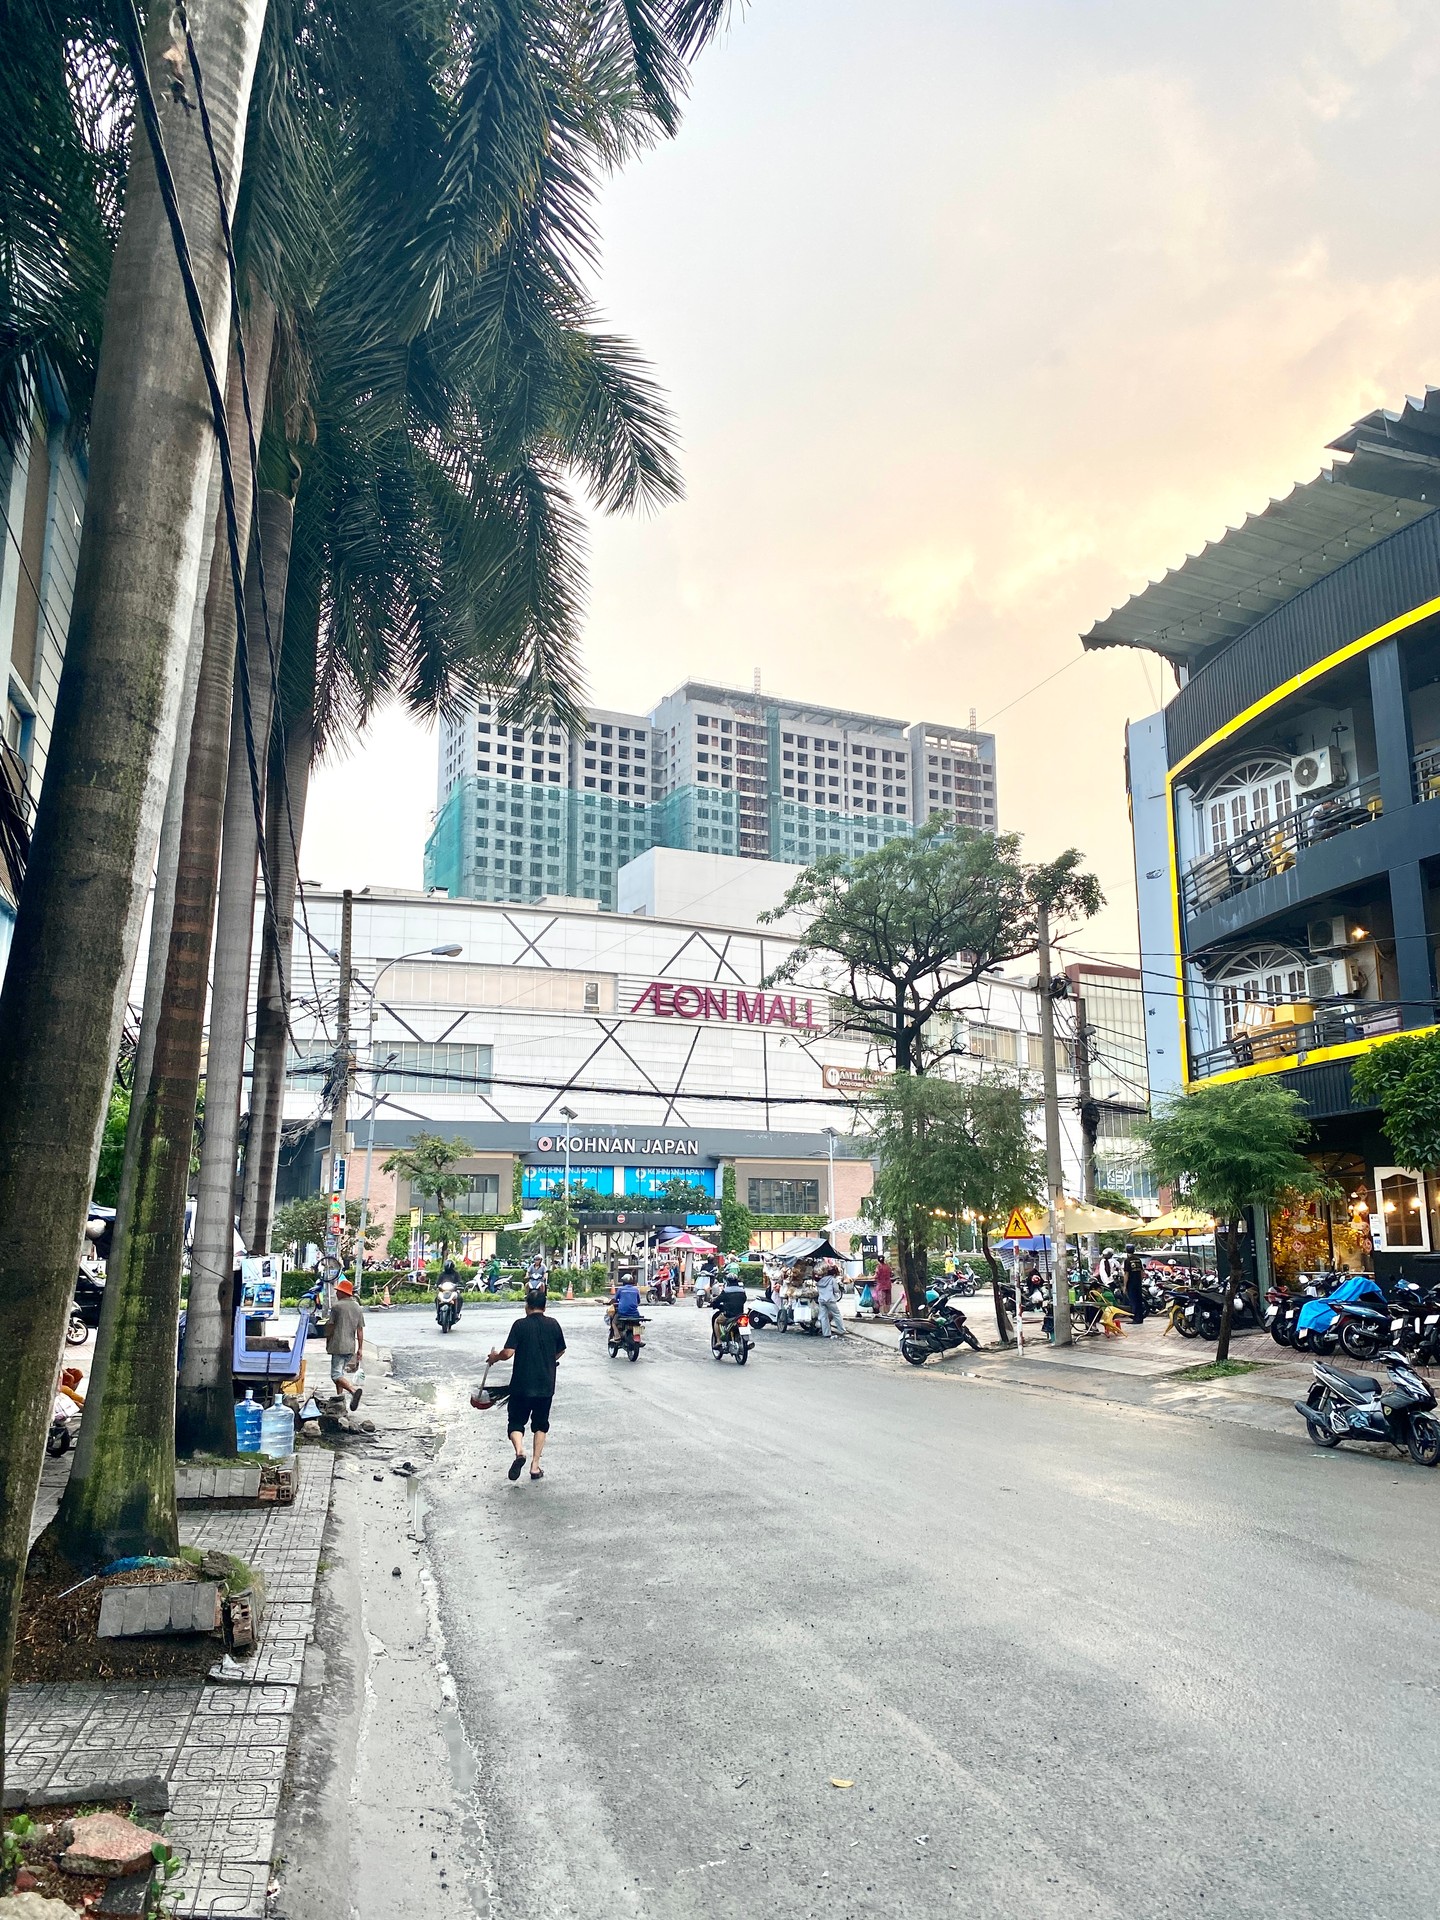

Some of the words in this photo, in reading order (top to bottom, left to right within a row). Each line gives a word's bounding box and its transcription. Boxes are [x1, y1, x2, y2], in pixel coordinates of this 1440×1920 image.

[736, 991, 821, 1030] MALL
[555, 1137, 636, 1154] KOHNAN
[641, 1139, 699, 1155] JAPAN
